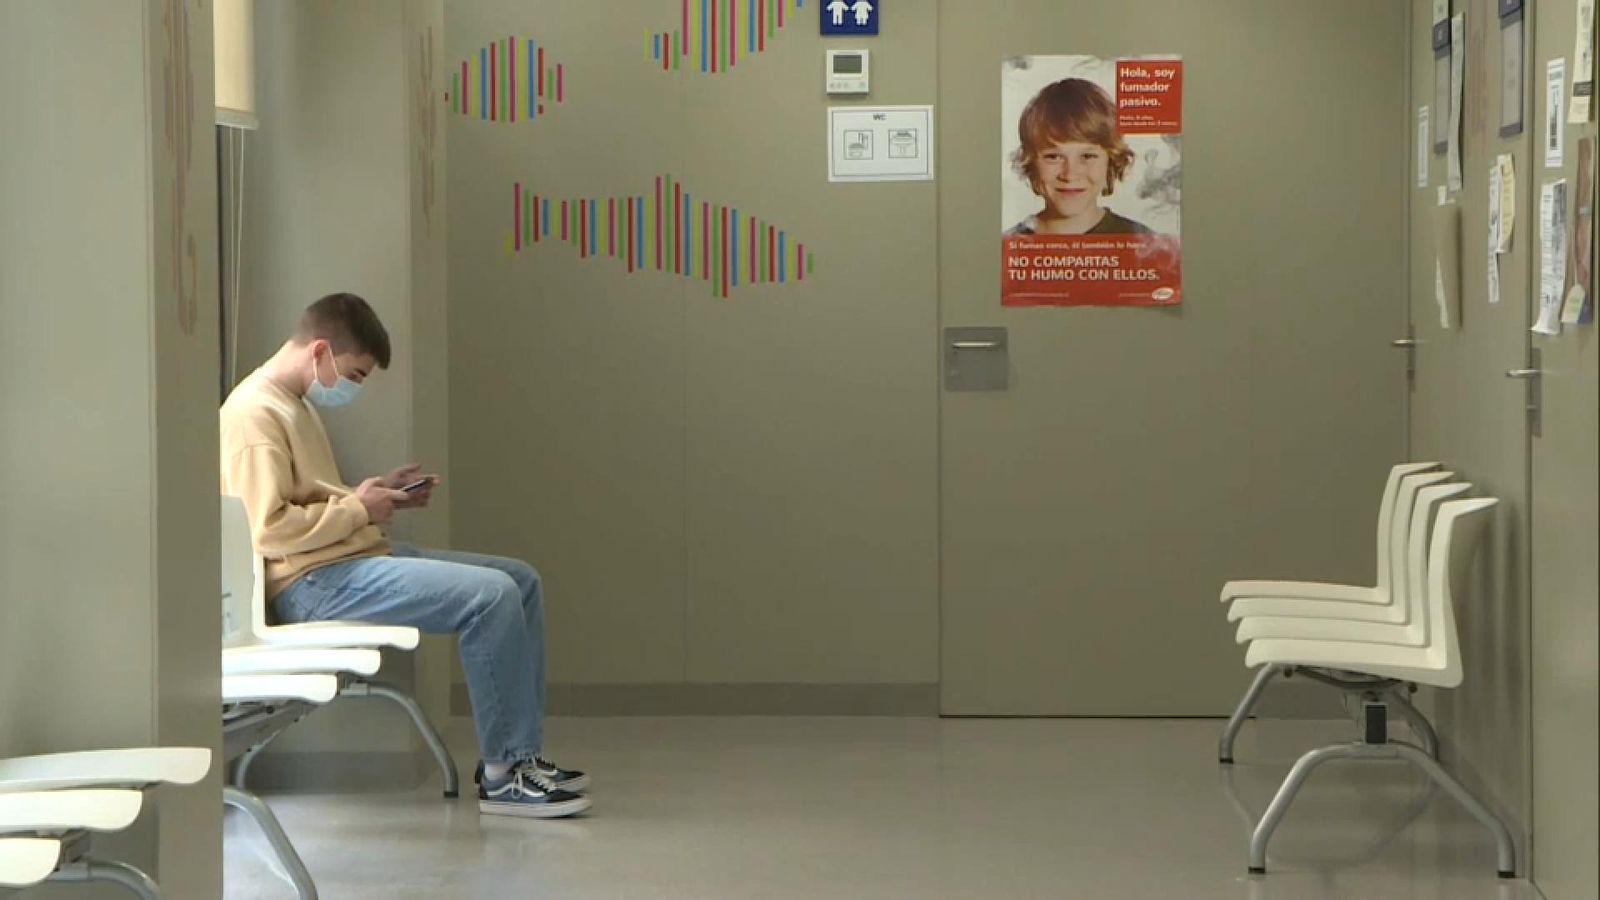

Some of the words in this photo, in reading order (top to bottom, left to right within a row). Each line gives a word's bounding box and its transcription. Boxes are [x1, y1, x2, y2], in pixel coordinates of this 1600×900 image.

[1120, 67, 1150, 78] Hola,
[1155, 69, 1176, 80] soy
[1120, 81, 1170, 93] fumador
[1120, 96, 1161, 108] pasivo.
[1019, 240, 1045, 250] fumas
[1008, 256, 1029, 267] NO
[1033, 256, 1120, 267] COMPARTAS
[1008, 269, 1026, 281] TU
[1031, 269, 1074, 281] HUMO
[1078, 269, 1109, 281] CON
[1112, 269, 1161, 281] ELLOS.
